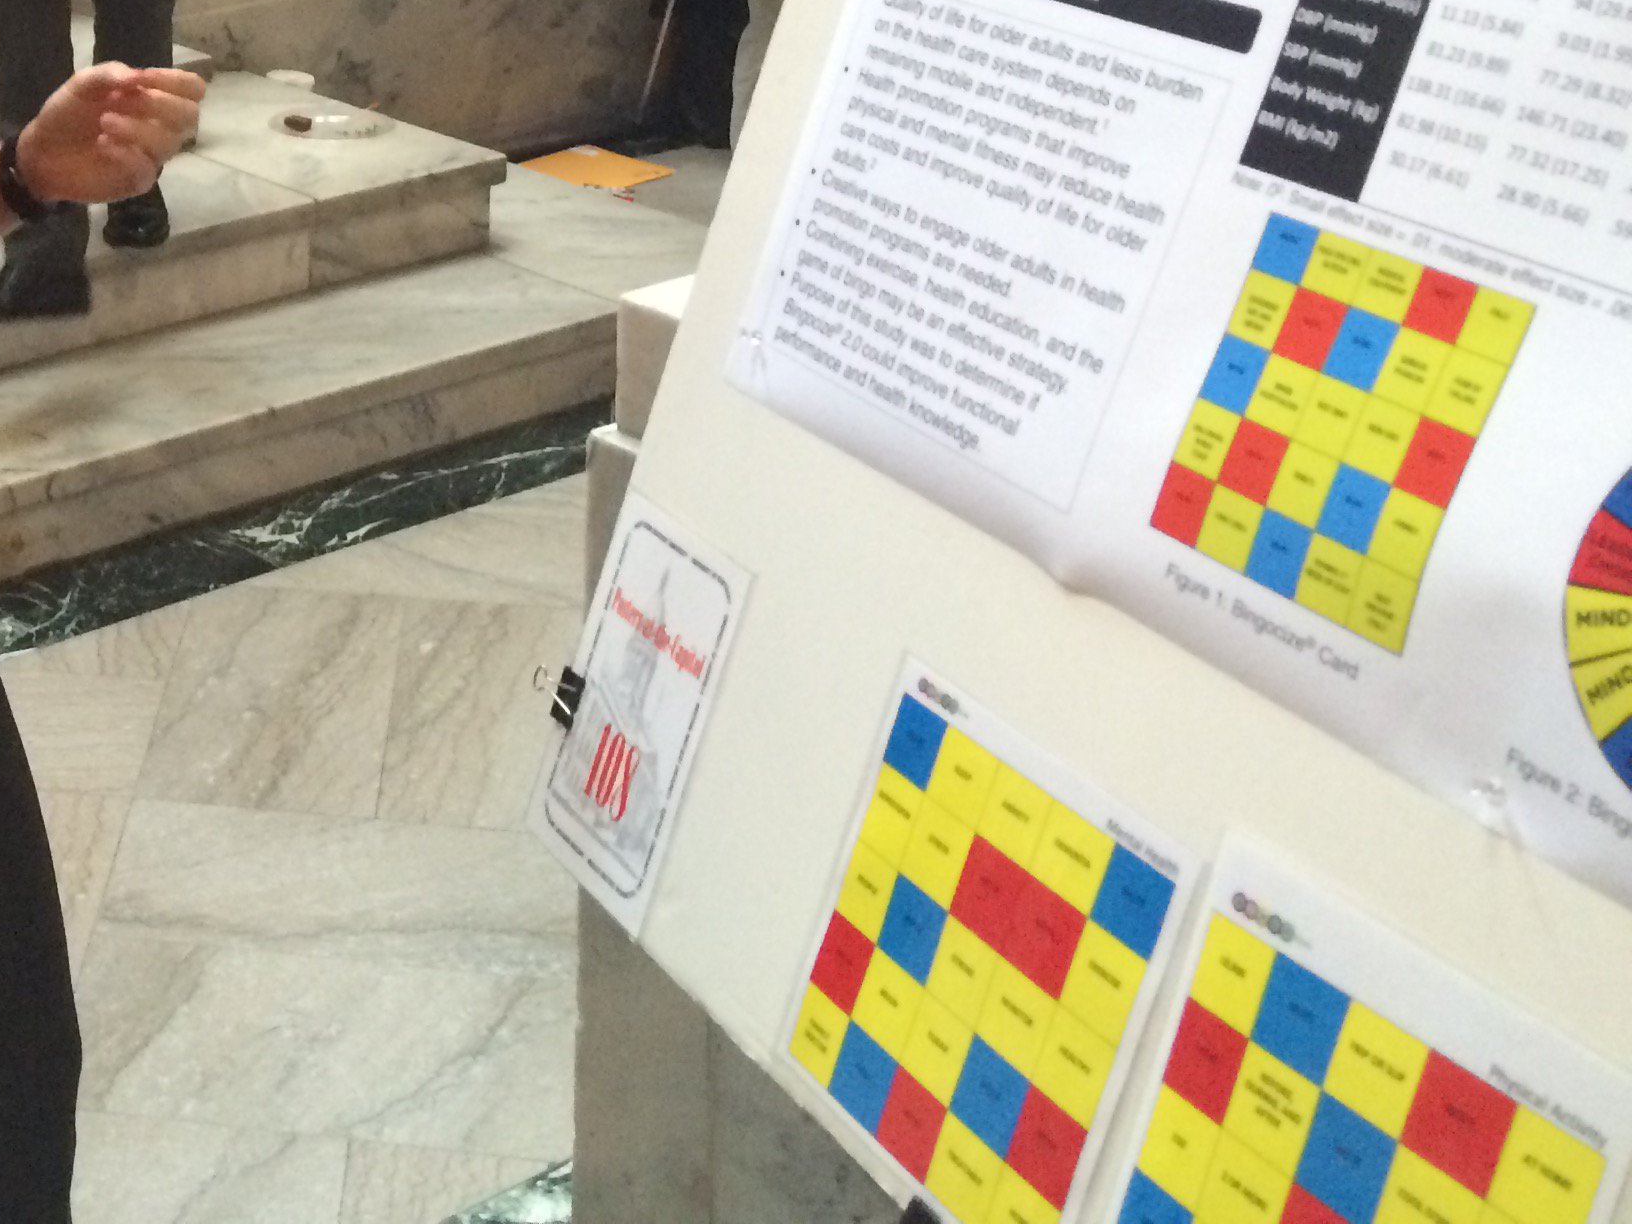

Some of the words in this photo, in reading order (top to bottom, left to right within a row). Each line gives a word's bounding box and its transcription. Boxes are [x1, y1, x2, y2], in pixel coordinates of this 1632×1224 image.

[1165, 562, 1212, 601] Figure
[1319, 644, 1360, 680] Card
[1505, 746, 1562, 795] Figure
